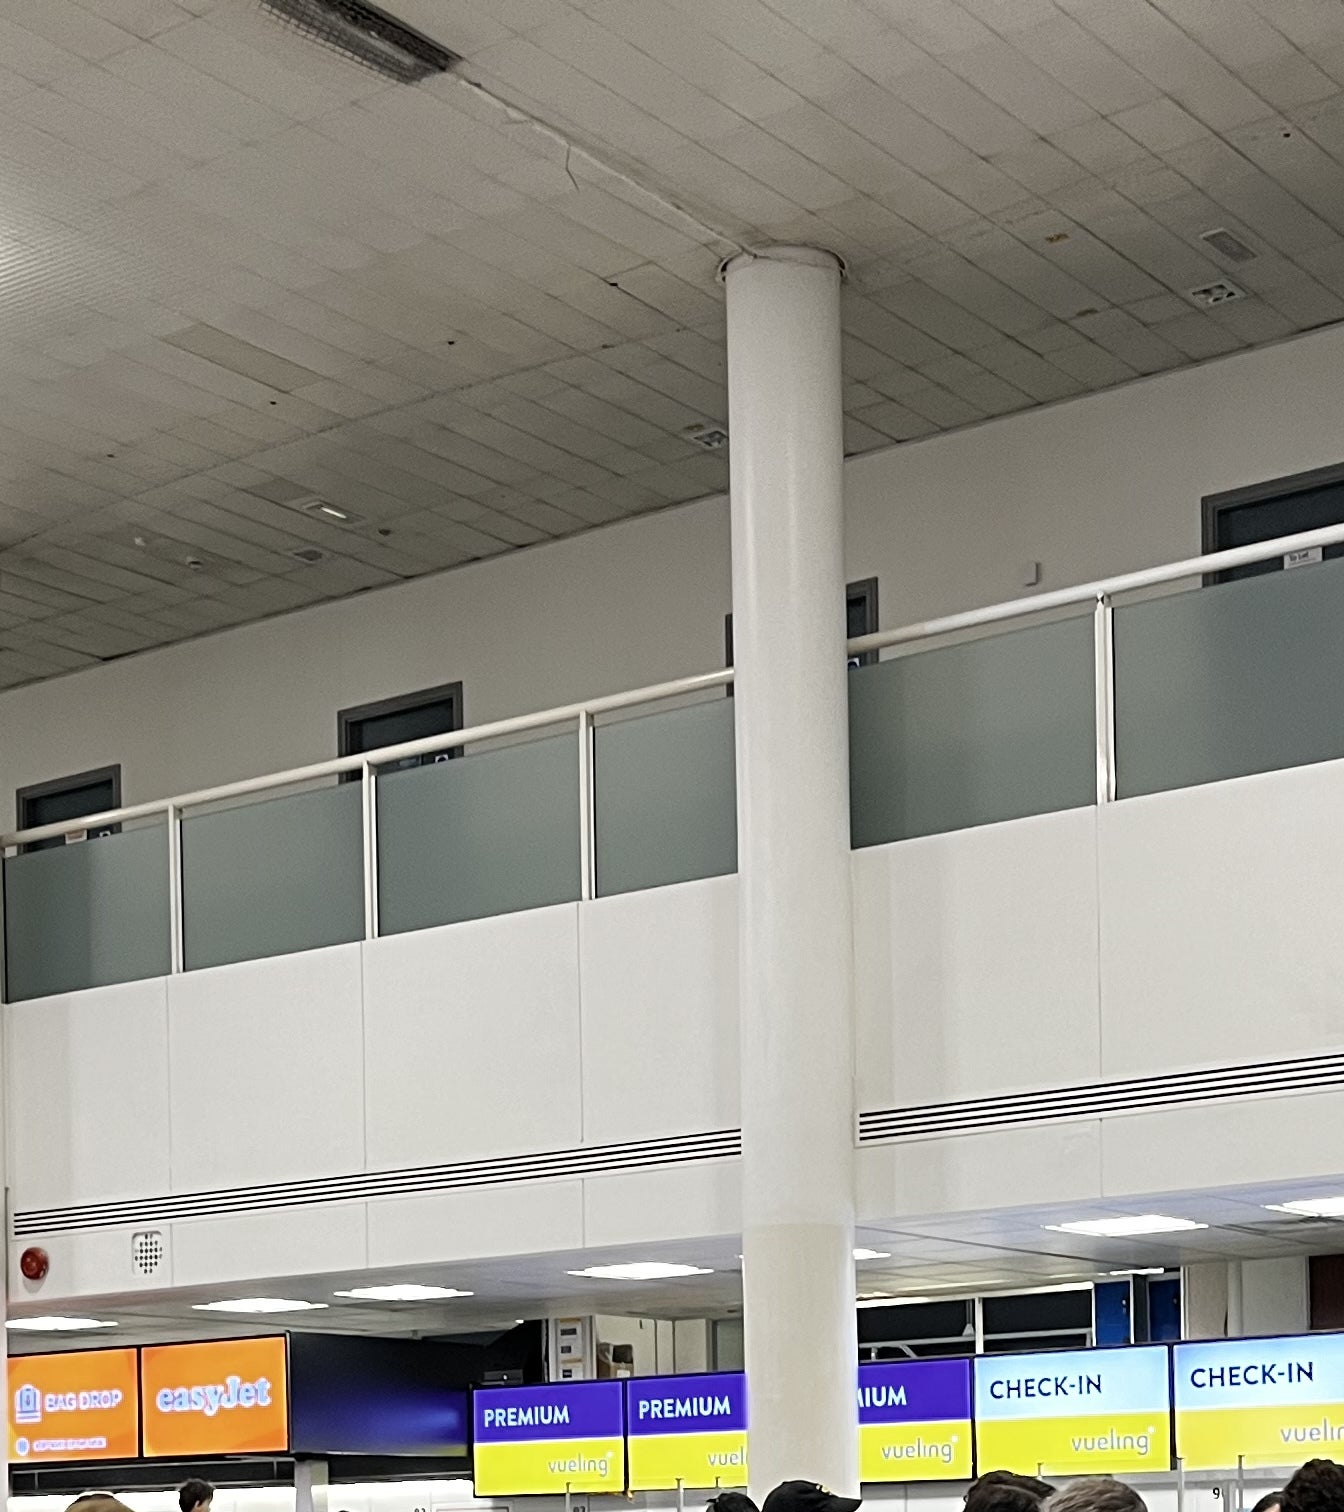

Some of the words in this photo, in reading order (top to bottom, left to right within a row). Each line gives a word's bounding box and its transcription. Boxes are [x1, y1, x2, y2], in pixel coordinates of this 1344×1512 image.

[990, 1374, 1102, 1399] CHECK-IN
[1190, 1362, 1314, 1388] CHECK-IN
[45, 1394, 77, 1412] BAG
[79, 1390, 122, 1411] DROP
[157, 1376, 271, 1416] easyJet
[639, 1395, 731, 1420] PREMIUM
[483, 1405, 570, 1427] PREMIUM
[882, 1438, 952, 1464] vueling
[1072, 1428, 1148, 1456] vueling
[548, 1453, 608, 1478] vueling
[708, 1446, 748, 1466] vuel
[1212, 1487, 1224, 1500] 9
